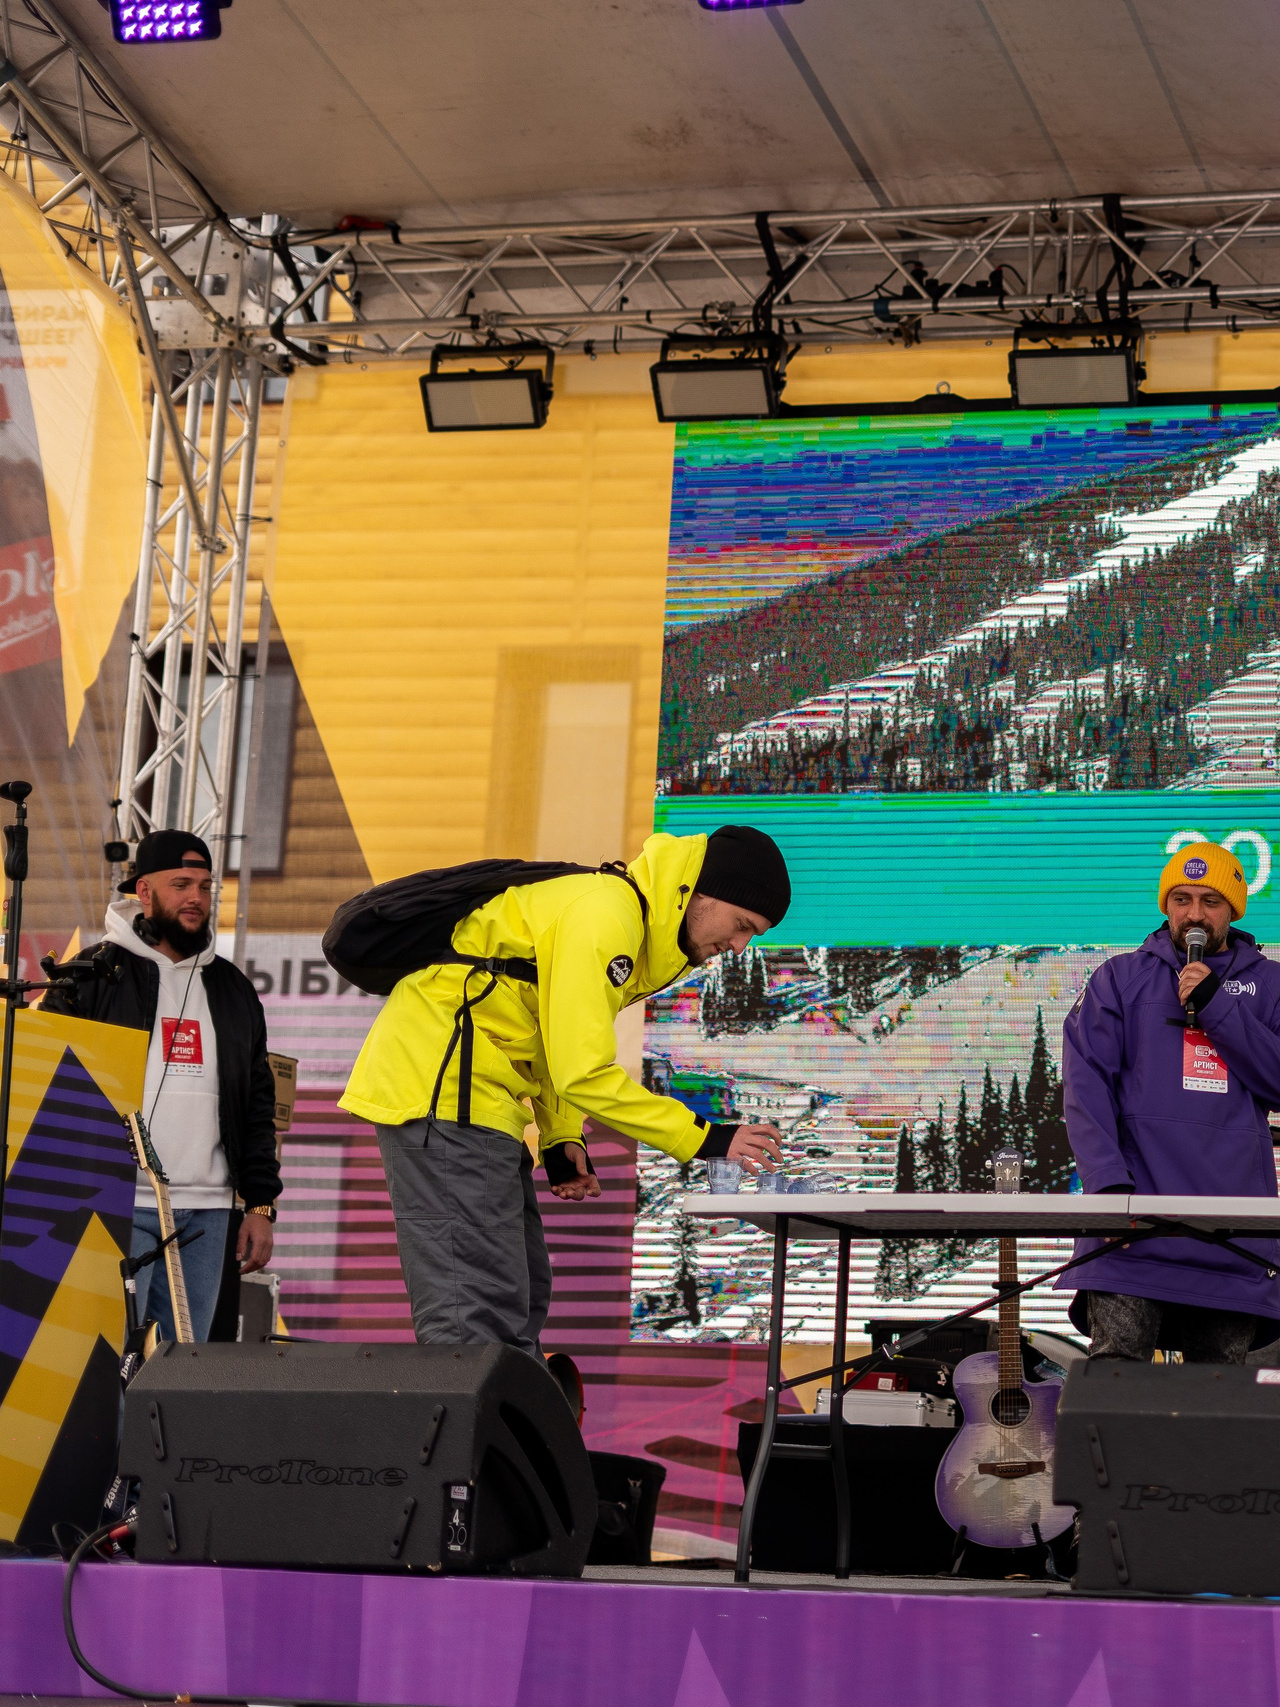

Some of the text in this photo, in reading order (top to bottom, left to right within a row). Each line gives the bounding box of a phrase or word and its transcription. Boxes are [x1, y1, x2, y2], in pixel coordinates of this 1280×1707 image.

[171, 1046, 194, 1055] АРТИСТ
[1193, 1060, 1218, 1070] АРТИСТ
[174, 1457, 408, 1487] ProTone
[452, 1508, 460, 1526] 4
